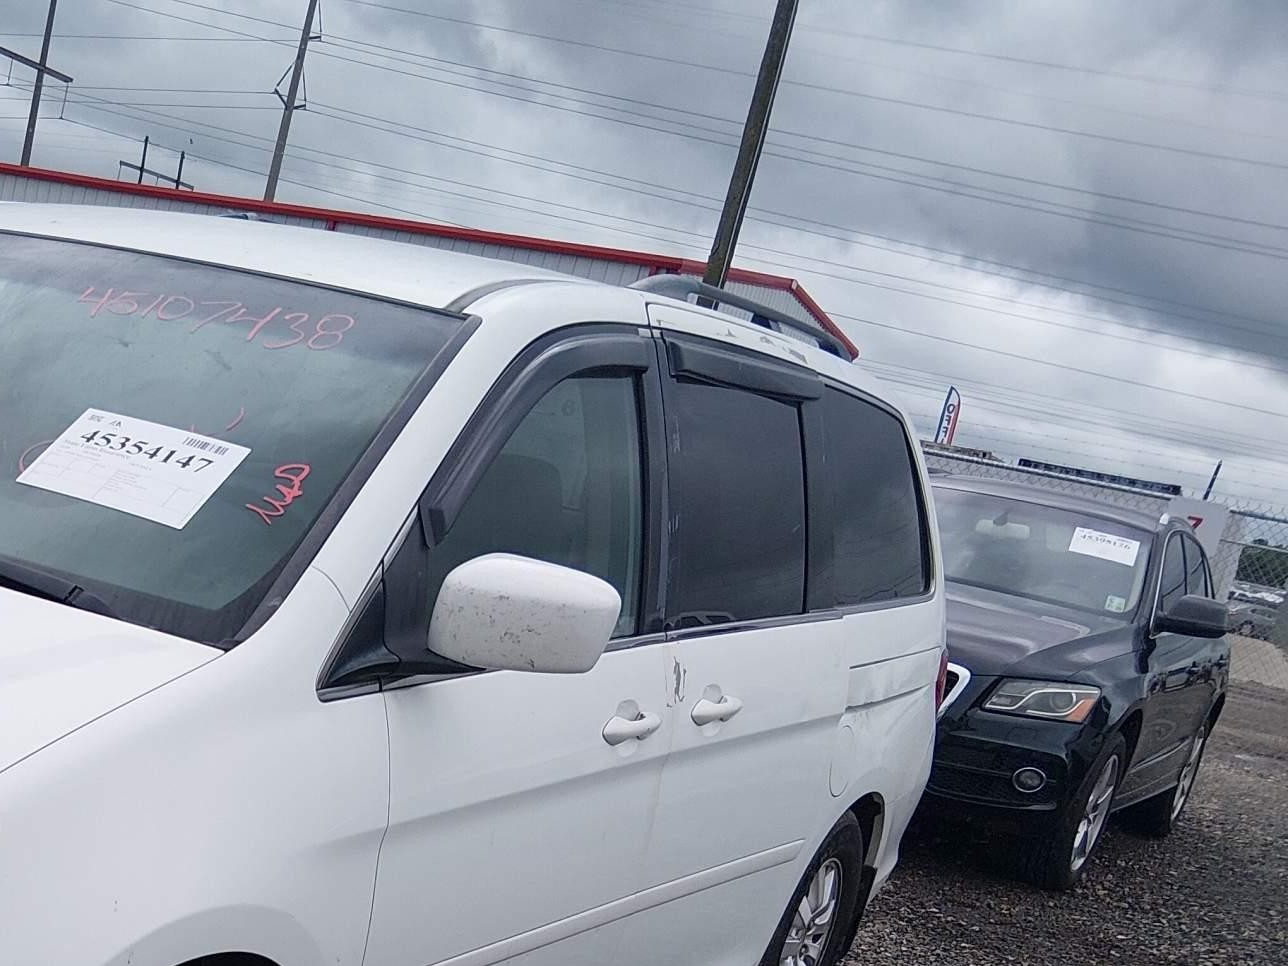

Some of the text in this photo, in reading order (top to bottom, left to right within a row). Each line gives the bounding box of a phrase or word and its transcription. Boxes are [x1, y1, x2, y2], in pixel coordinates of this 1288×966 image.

[77, 286, 355, 350] 45107438
[80, 429, 215, 474] 45354147
[1187, 516, 1203, 530] 7
